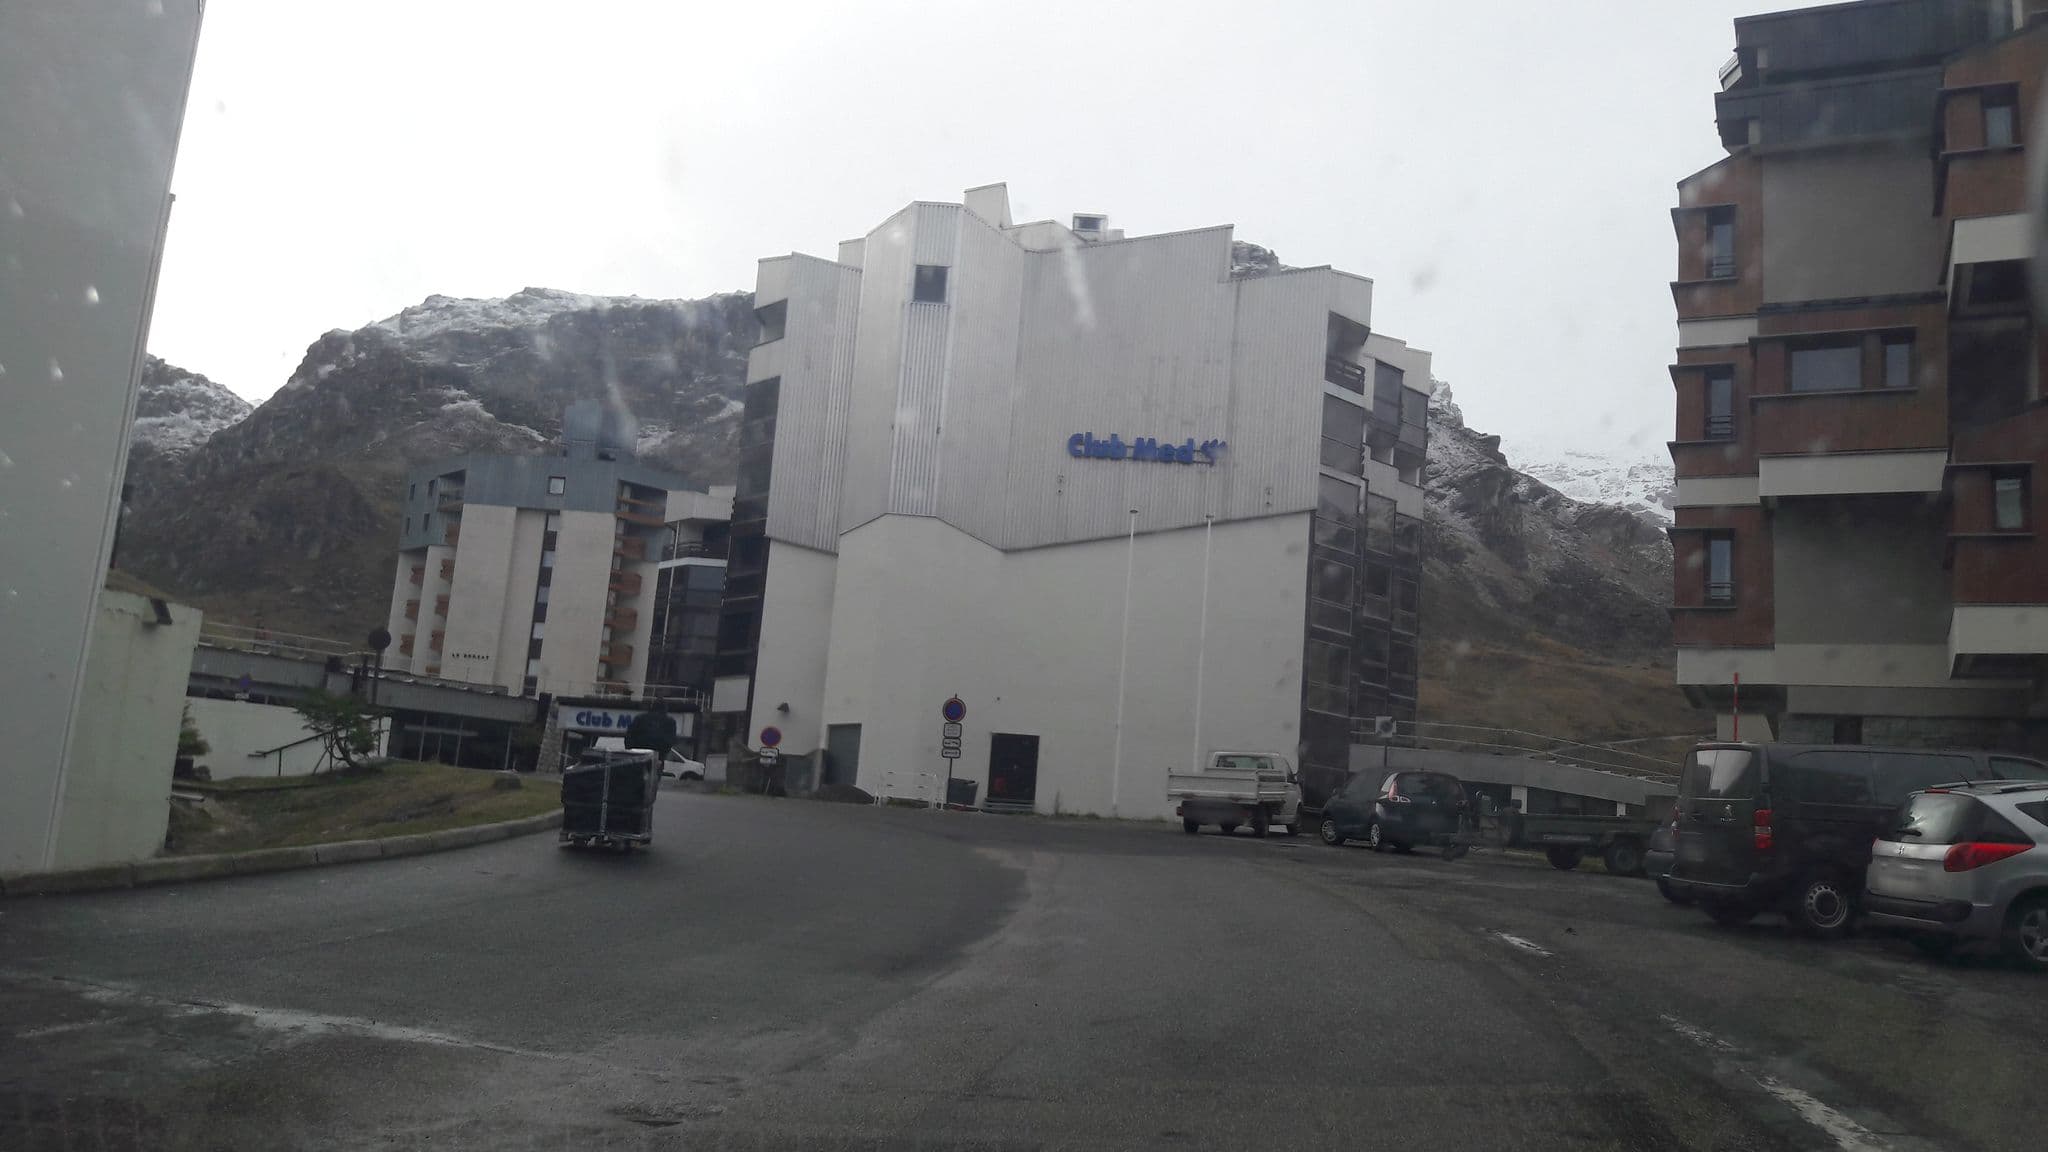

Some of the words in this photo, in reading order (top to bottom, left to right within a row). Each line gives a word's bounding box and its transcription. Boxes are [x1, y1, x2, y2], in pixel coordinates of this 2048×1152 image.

[1068, 431, 1127, 460] Club
[1133, 438, 1194, 464] Med
[576, 711, 613, 728] Club
